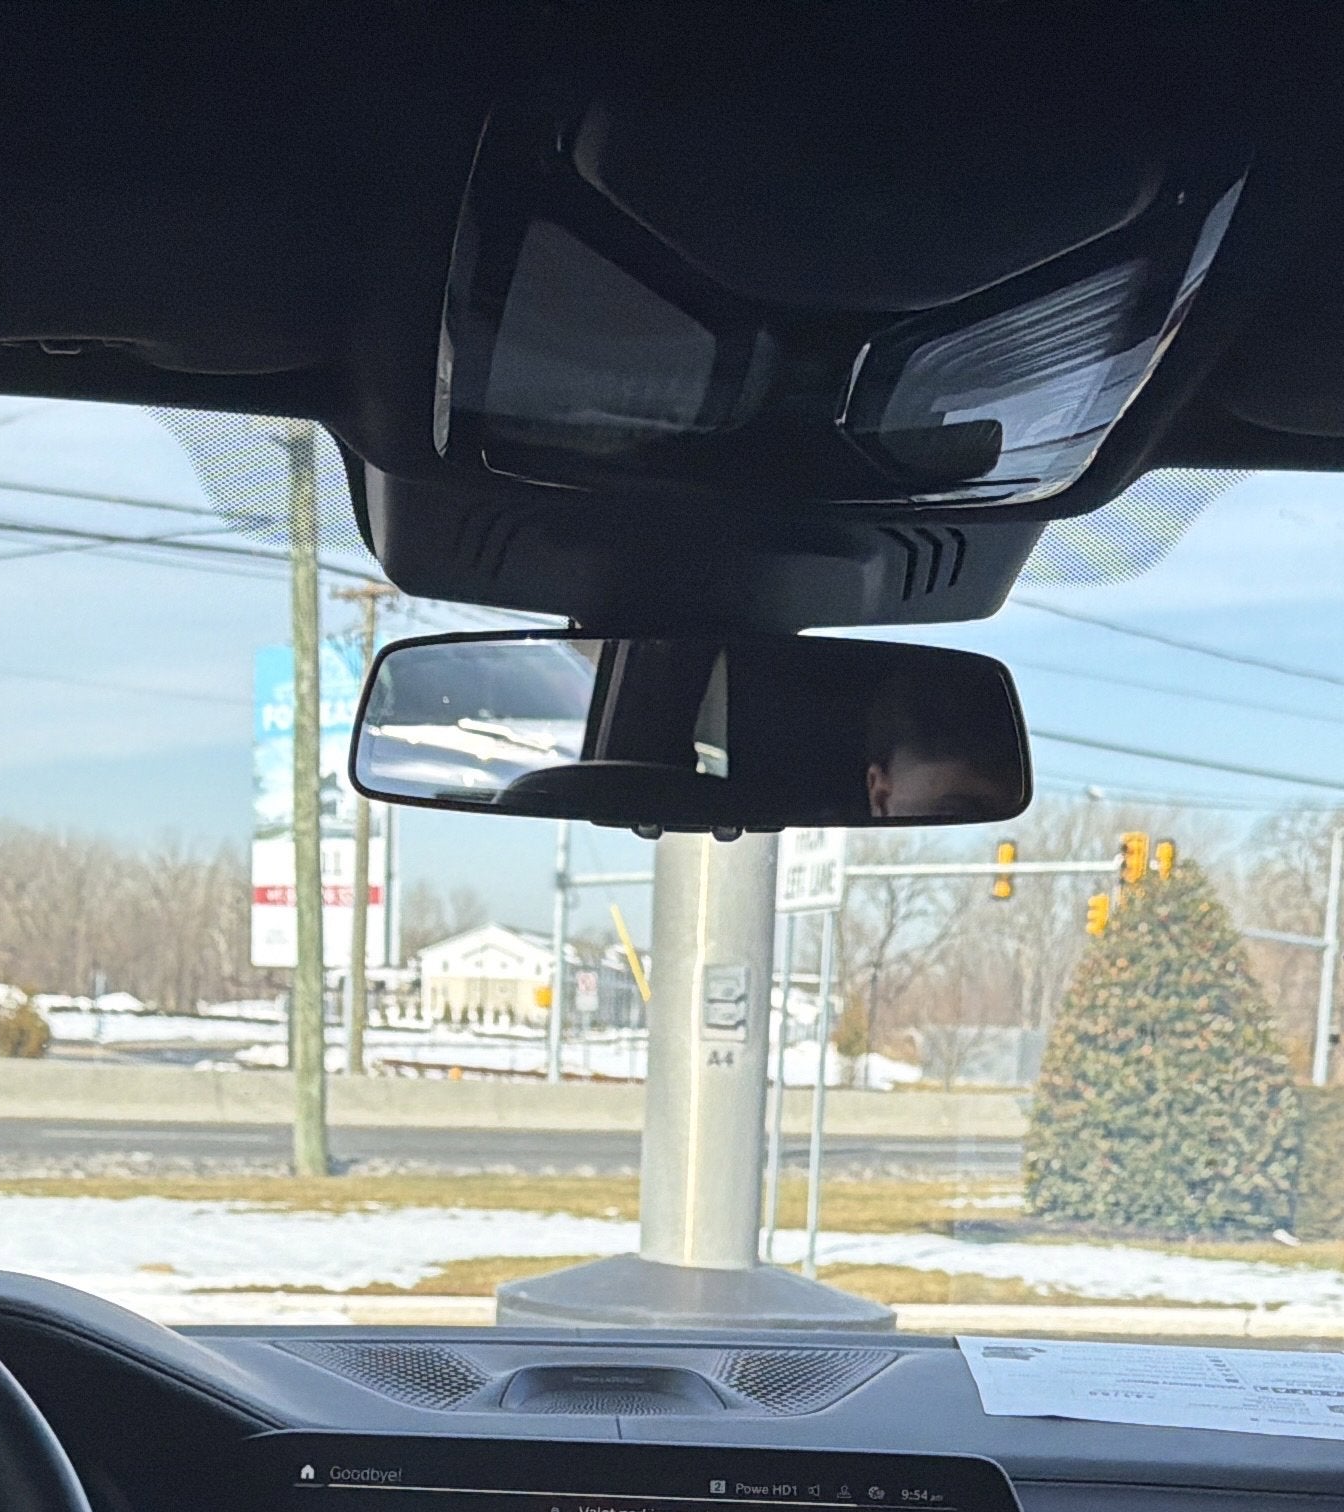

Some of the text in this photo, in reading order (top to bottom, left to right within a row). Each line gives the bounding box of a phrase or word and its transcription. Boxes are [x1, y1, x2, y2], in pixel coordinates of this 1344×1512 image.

[707, 1050, 734, 1066] A4
[329, 1465, 403, 1484] Goodbye!
[735, 1483, 769, 1495] Powe
[772, 1485, 798, 1497] HD1
[901, 1489, 928, 1501] 9:54
